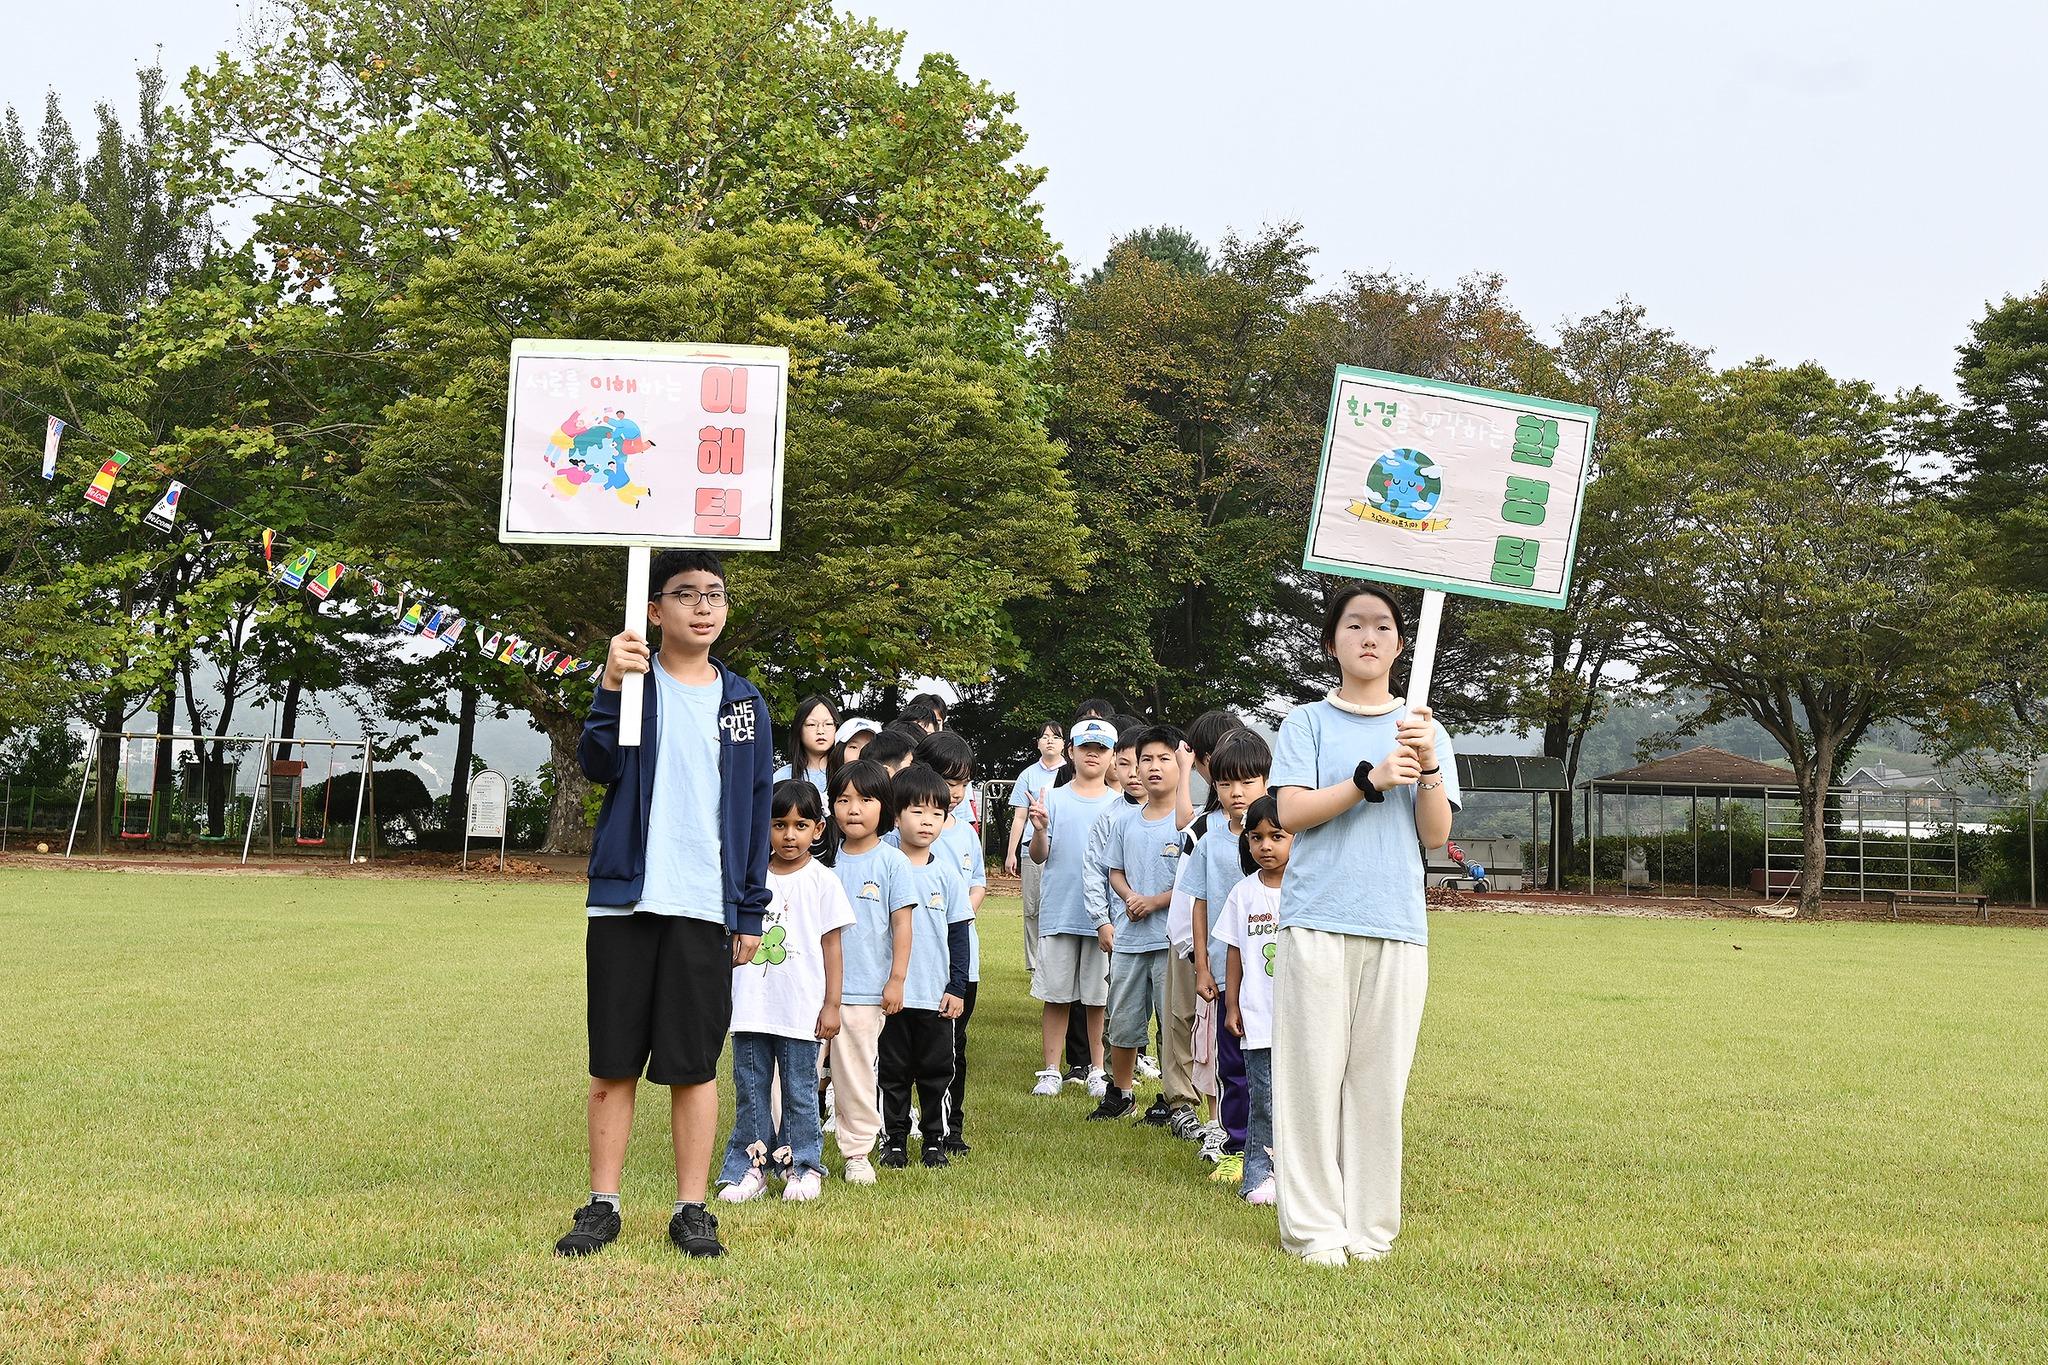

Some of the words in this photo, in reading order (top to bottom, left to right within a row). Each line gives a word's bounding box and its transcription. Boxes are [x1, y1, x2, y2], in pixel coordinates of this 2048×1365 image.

[525, 368, 580, 399] 서로를
[589, 374, 682, 401] 이해하는
[1346, 395, 1410, 435] 환경을
[1419, 411, 1505, 449] 생각하는
[732, 700, 753, 715] HE
